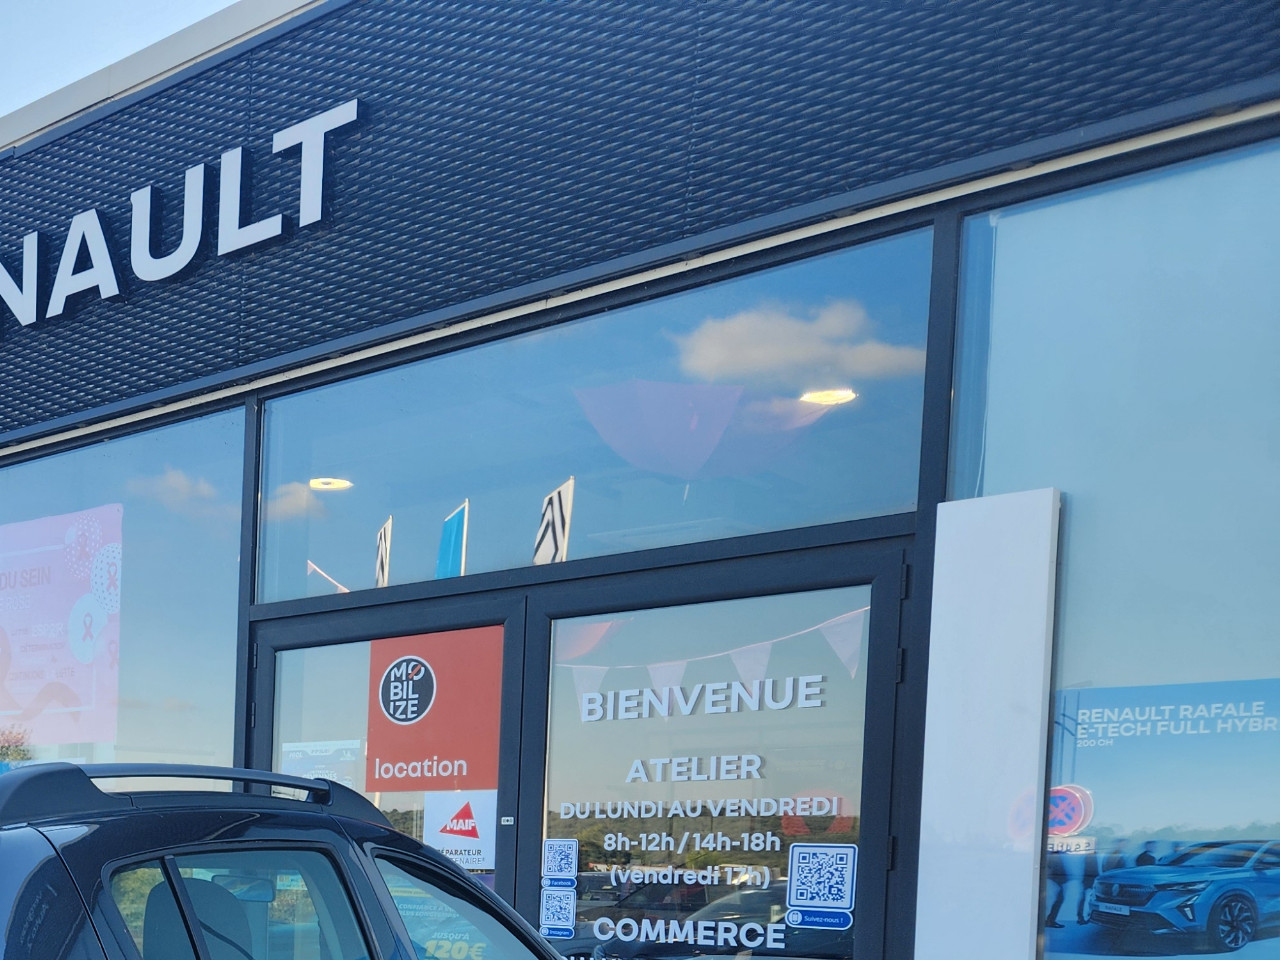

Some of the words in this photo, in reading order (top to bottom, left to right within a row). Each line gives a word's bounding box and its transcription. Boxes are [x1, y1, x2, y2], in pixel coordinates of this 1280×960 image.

[0, 571, 18, 591] DU
[20, 566, 52, 588] SEIN
[580, 674, 824, 723] BIENVENUE
[1077, 704, 1175, 723] RENAULT
[1179, 701, 1265, 719] RAFALE
[1076, 721, 1151, 739] E-TECH
[1156, 718, 1211, 736] FULL
[1216, 716, 1280, 733] HYBR
[1076, 739, 1096, 748] 200
[1097, 738, 1114, 747] CH
[374, 755, 468, 779] location
[624, 753, 763, 783] ATELIER
[559, 801, 590, 820] DU
[595, 800, 664, 819] LUNDI
[667, 799, 703, 819] AU
[707, 796, 838, 818] VENDREDI
[446, 819, 477, 832] MAIF
[439, 847, 482, 856] ÉPARATEUR
[603, 832, 675, 852] 8h-12h
[676, 832, 690, 855] /
[693, 831, 781, 852] 14h-18h
[609, 865, 721, 888] (vendredi
[724, 866, 771, 890] 17h)
[803, 914, 838, 925] Suivez-nous
[592, 916, 787, 950] COMMERCE
[424, 940, 487, 960] 120€
